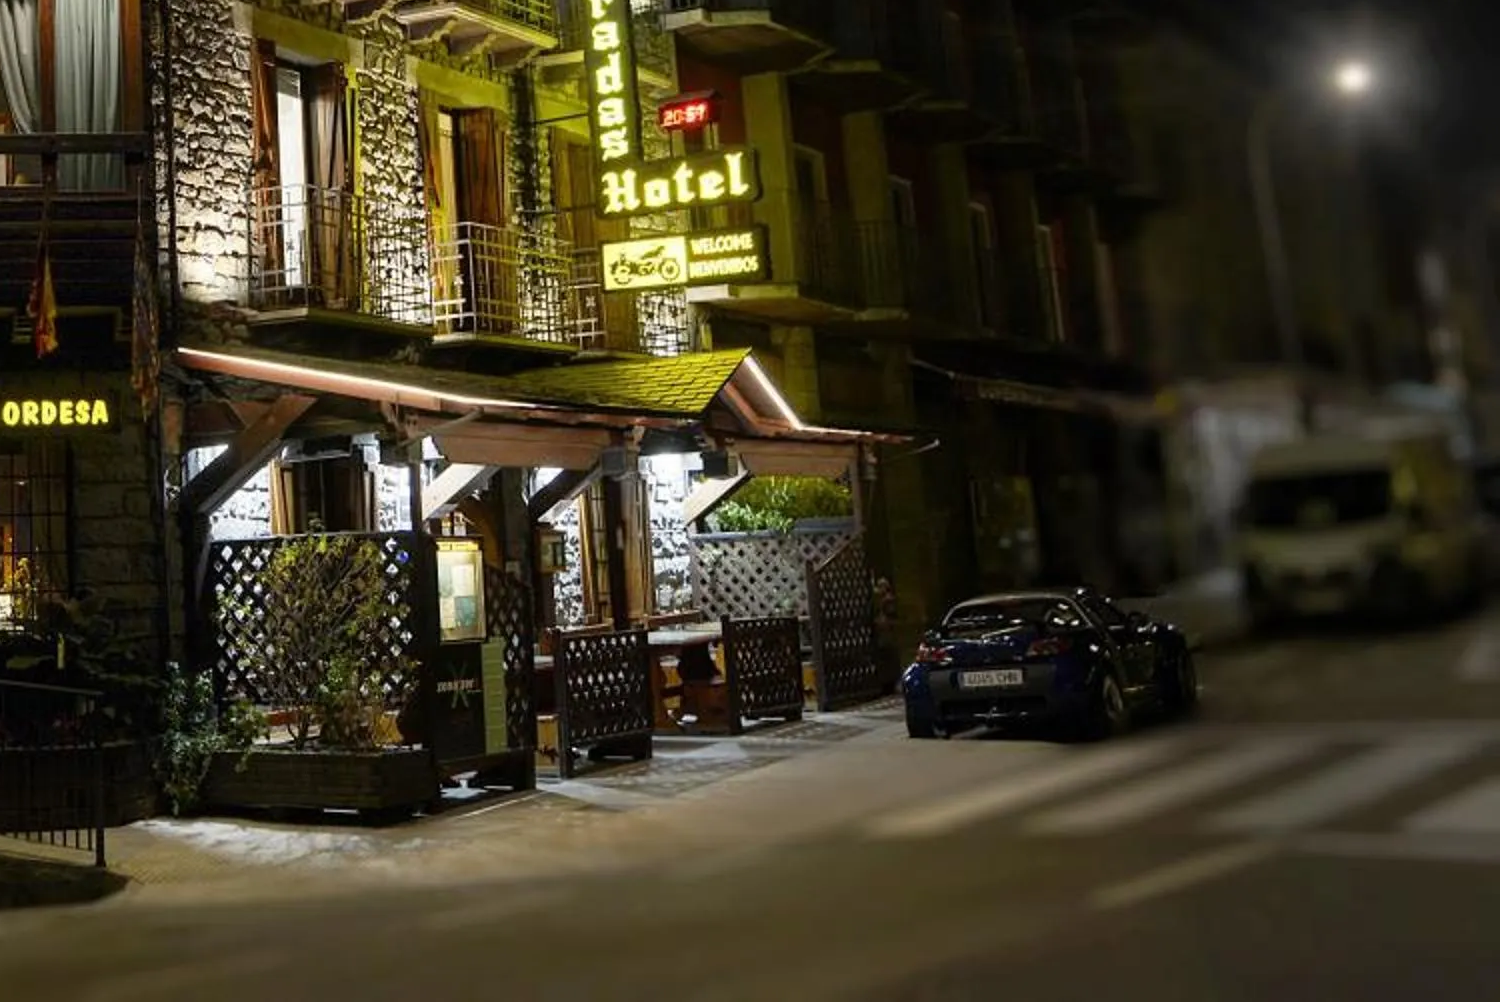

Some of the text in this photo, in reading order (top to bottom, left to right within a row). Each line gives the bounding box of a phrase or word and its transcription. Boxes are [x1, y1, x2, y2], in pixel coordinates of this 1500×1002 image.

[601, 151, 749, 214] Hotel
[691, 233, 754, 255] WELCOME
[2, 399, 109, 426] ORDESA
